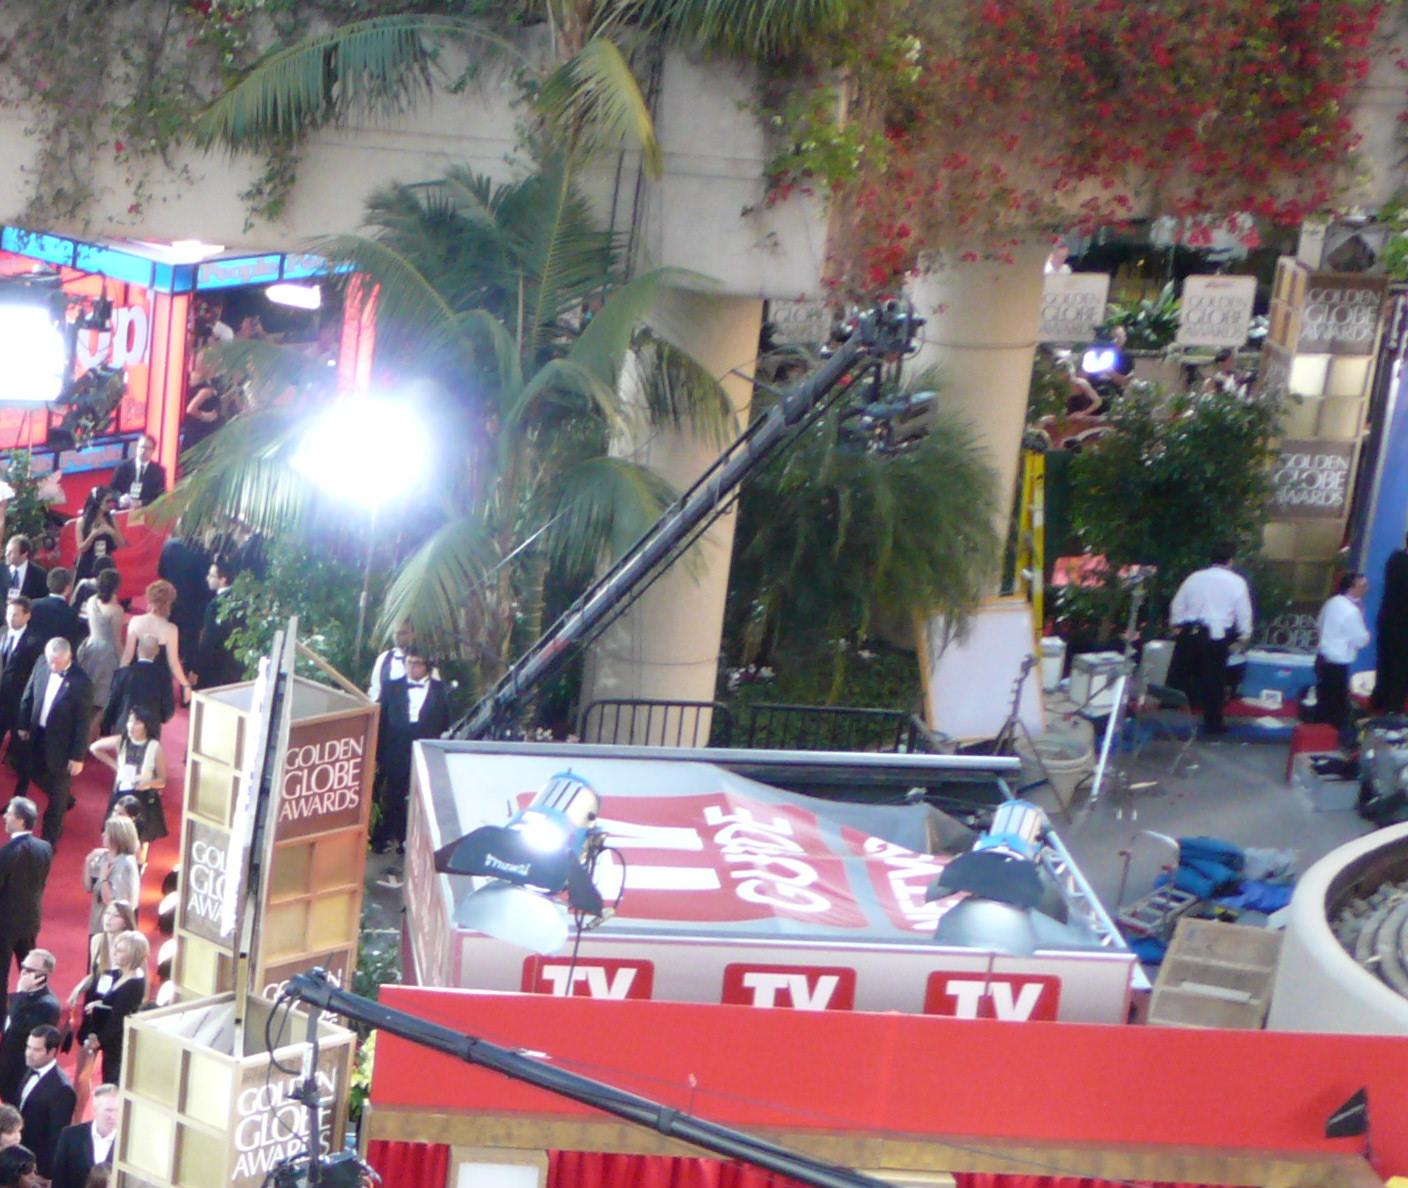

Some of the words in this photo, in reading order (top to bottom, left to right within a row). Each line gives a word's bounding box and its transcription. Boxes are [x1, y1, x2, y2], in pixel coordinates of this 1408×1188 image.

[1303, 303, 1378, 324] GLOBE
[1308, 288, 1382, 304] GOLDEN
[285, 736, 365, 769] GOLDEN
[283, 757, 362, 800] GLOBE
[278, 785, 360, 822] AWARDS
[542, 965, 638, 1000] TV
[743, 972, 840, 1011] TV
[945, 980, 1044, 1021] TV
